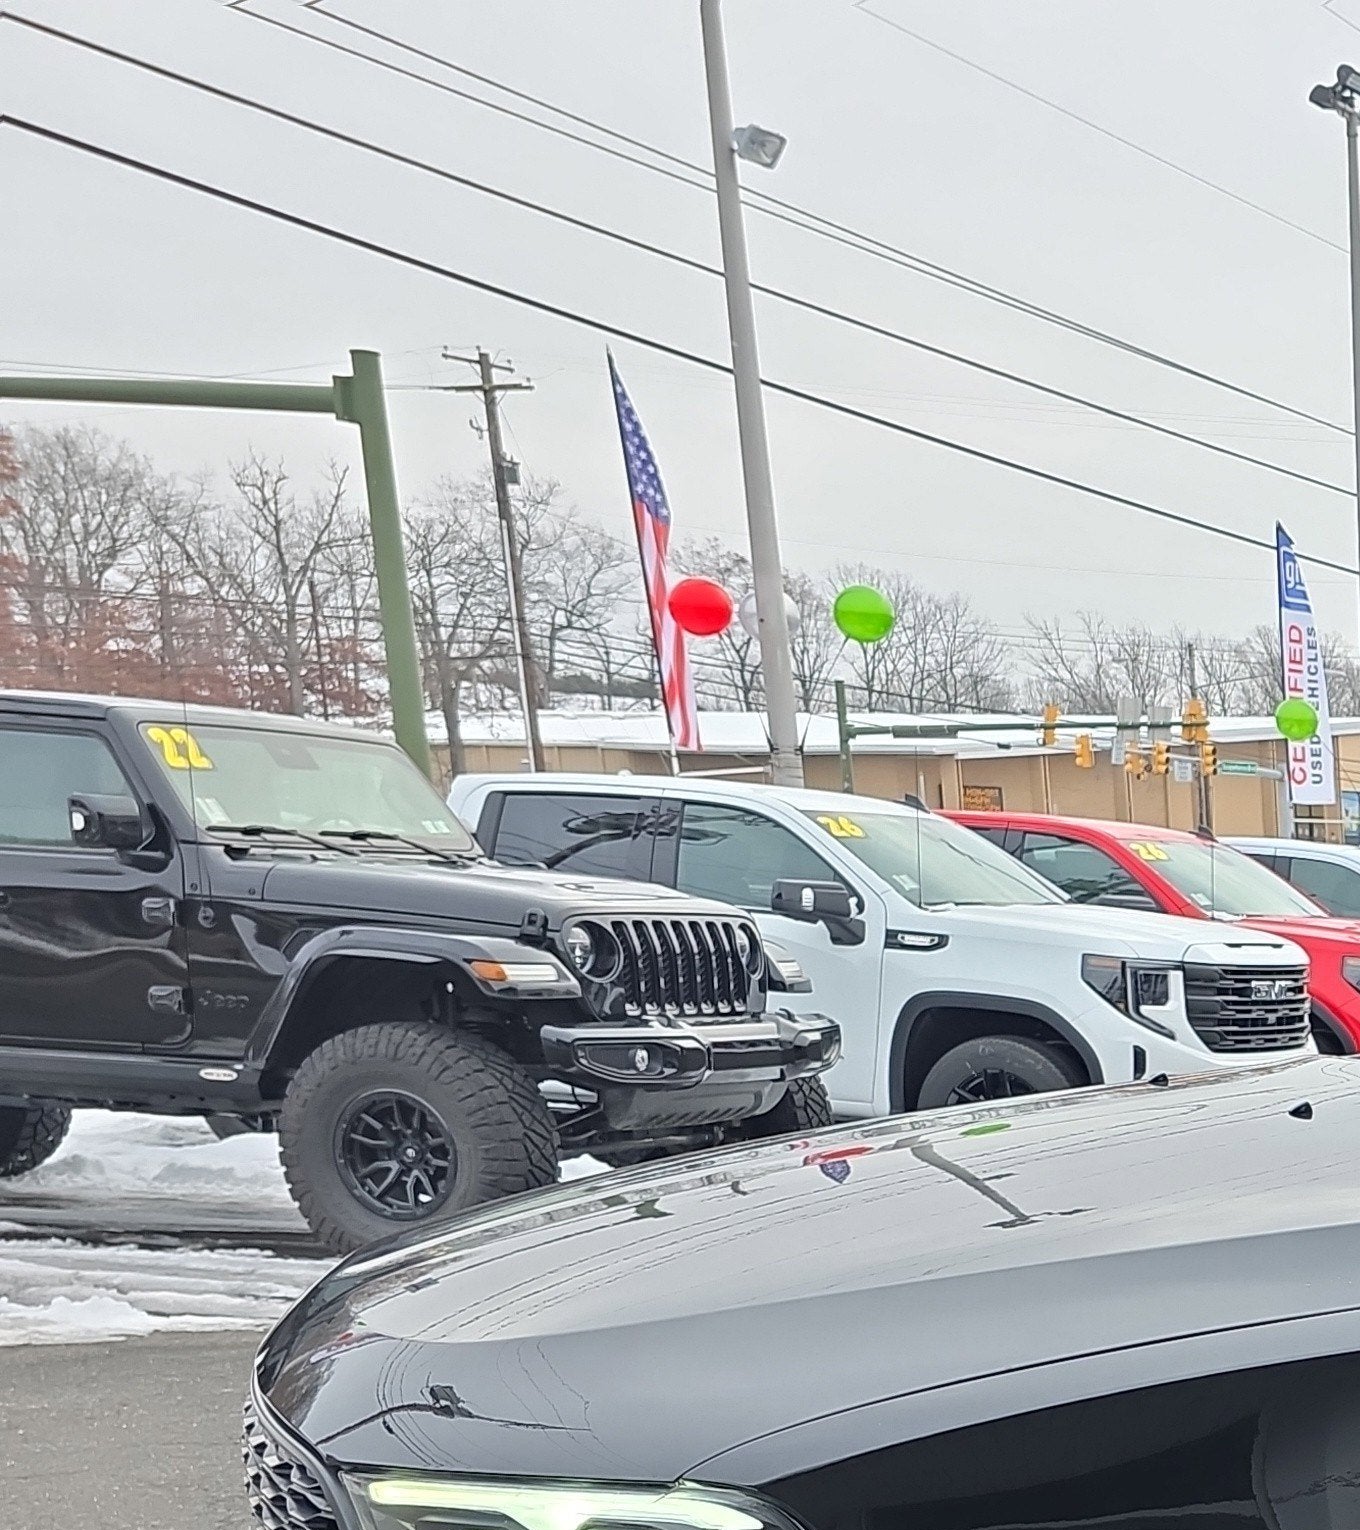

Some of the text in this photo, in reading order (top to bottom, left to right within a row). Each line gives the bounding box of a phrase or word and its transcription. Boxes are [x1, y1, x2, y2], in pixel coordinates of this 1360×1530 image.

[146, 727, 213, 770] 22
[1310, 733, 1324, 785] USED
[816, 816, 866, 838] 26
